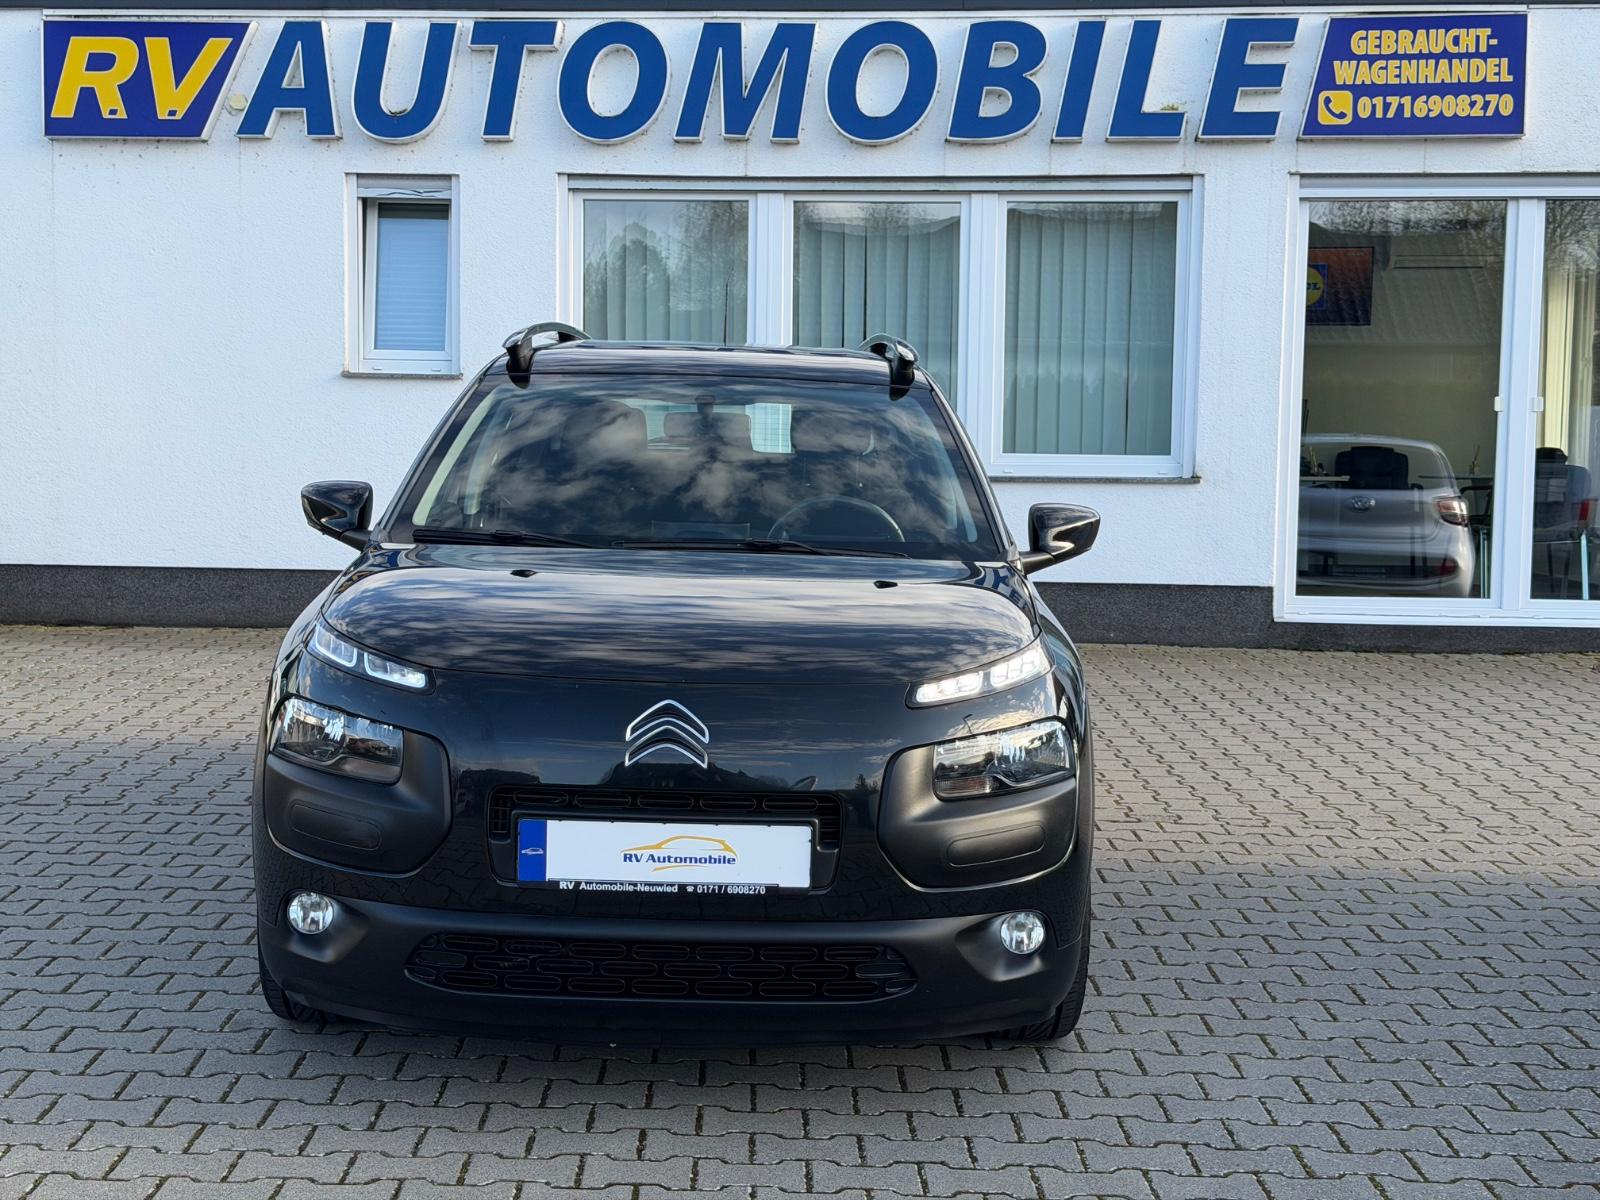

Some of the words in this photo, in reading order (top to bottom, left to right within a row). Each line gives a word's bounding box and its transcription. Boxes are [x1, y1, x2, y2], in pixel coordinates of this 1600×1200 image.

[1350, 27, 1499, 56] GEBRAUCHT-
[50, 36, 233, 120] RV
[236, 18, 1301, 143] AUTOMOBILE
[1333, 57, 1514, 85] WAGENHANDEL
[1356, 93, 1514, 119] 01716908270
[623, 853, 644, 863] RV
[646, 854, 736, 865] Automobile
[559, 881, 575, 890] RV
[579, 881, 679, 893] Automobile-Neuwied
[696, 885, 719, 894] 0171
[726, 885, 766, 895] 6908270
